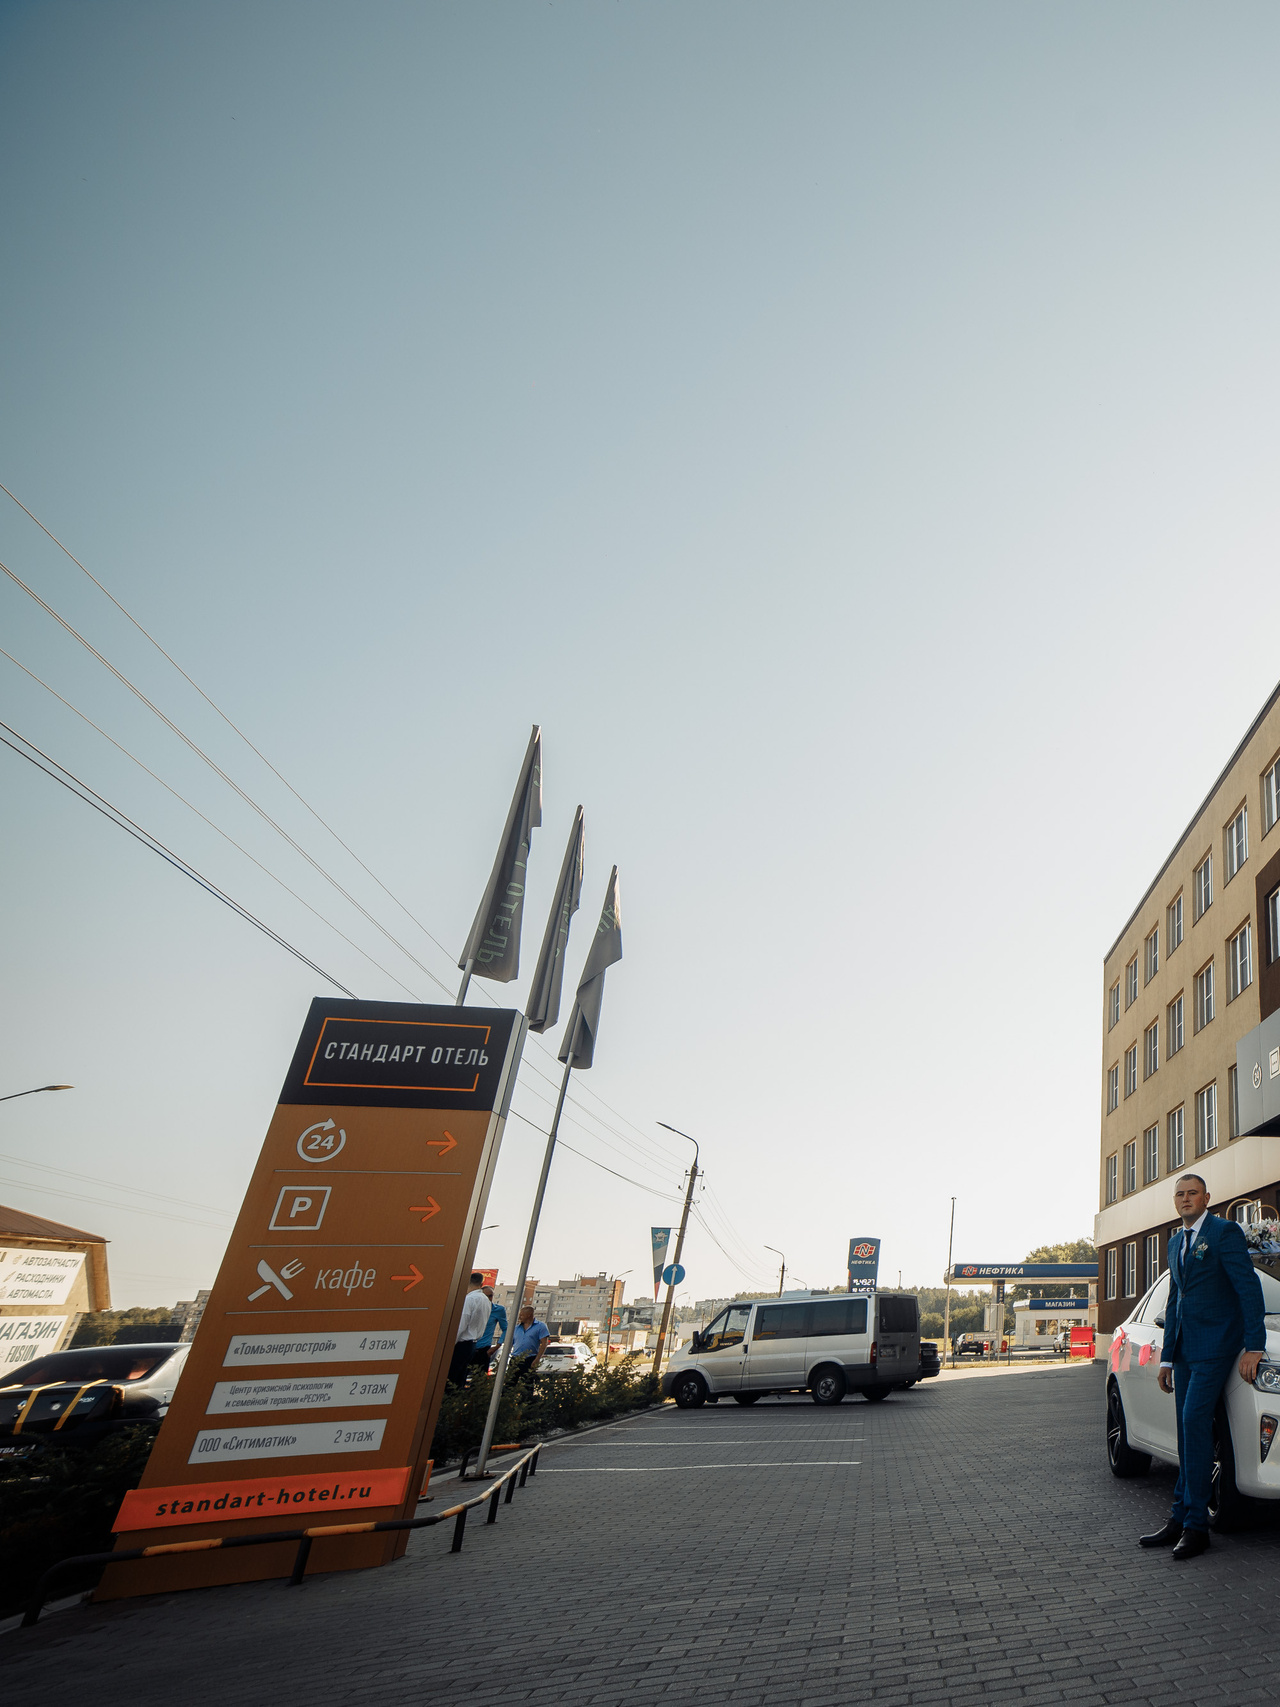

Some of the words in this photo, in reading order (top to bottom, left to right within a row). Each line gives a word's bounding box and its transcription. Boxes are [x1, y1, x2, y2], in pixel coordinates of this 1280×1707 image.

[324, 1042, 426, 1063] СТАНДАРТ
[430, 1047, 489, 1066] ОТЕЛЬ
[306, 1134, 335, 1150] 24
[289, 1196, 313, 1218] P
[22, 1256, 81, 1268] АВТОЗАПЧАСТИ
[14, 1273, 67, 1284] РАСХОДНИКИ
[314, 1260, 377, 1297] кафе
[979, 1267, 1024, 1275] НЕФТИКА
[7, 1289, 54, 1299] АВТОМАСЛА
[4, 1344, 40, 1363] FUSION
[233, 1340, 337, 1356] «Томьэнергострой»
[359, 1337, 368, 1350] 4
[369, 1338, 398, 1350] этаж
[229, 1385, 252, 1395] Центр
[252, 1383, 292, 1394] кризисной
[292, 1382, 334, 1393] психологии
[349, 1382, 358, 1395] 2
[359, 1382, 389, 1395] этаж
[231, 1397, 268, 1407] семейной
[269, 1396, 299, 1406] терапии
[300, 1393, 331, 1403] «РЕСУРС»
[198, 1437, 222, 1453] ООО
[222, 1435, 297, 1450] «Ситиматик»
[333, 1429, 342, 1444] 2
[343, 1430, 375, 1443] этаж
[155, 1485, 372, 1517] standart-hotel.ru
